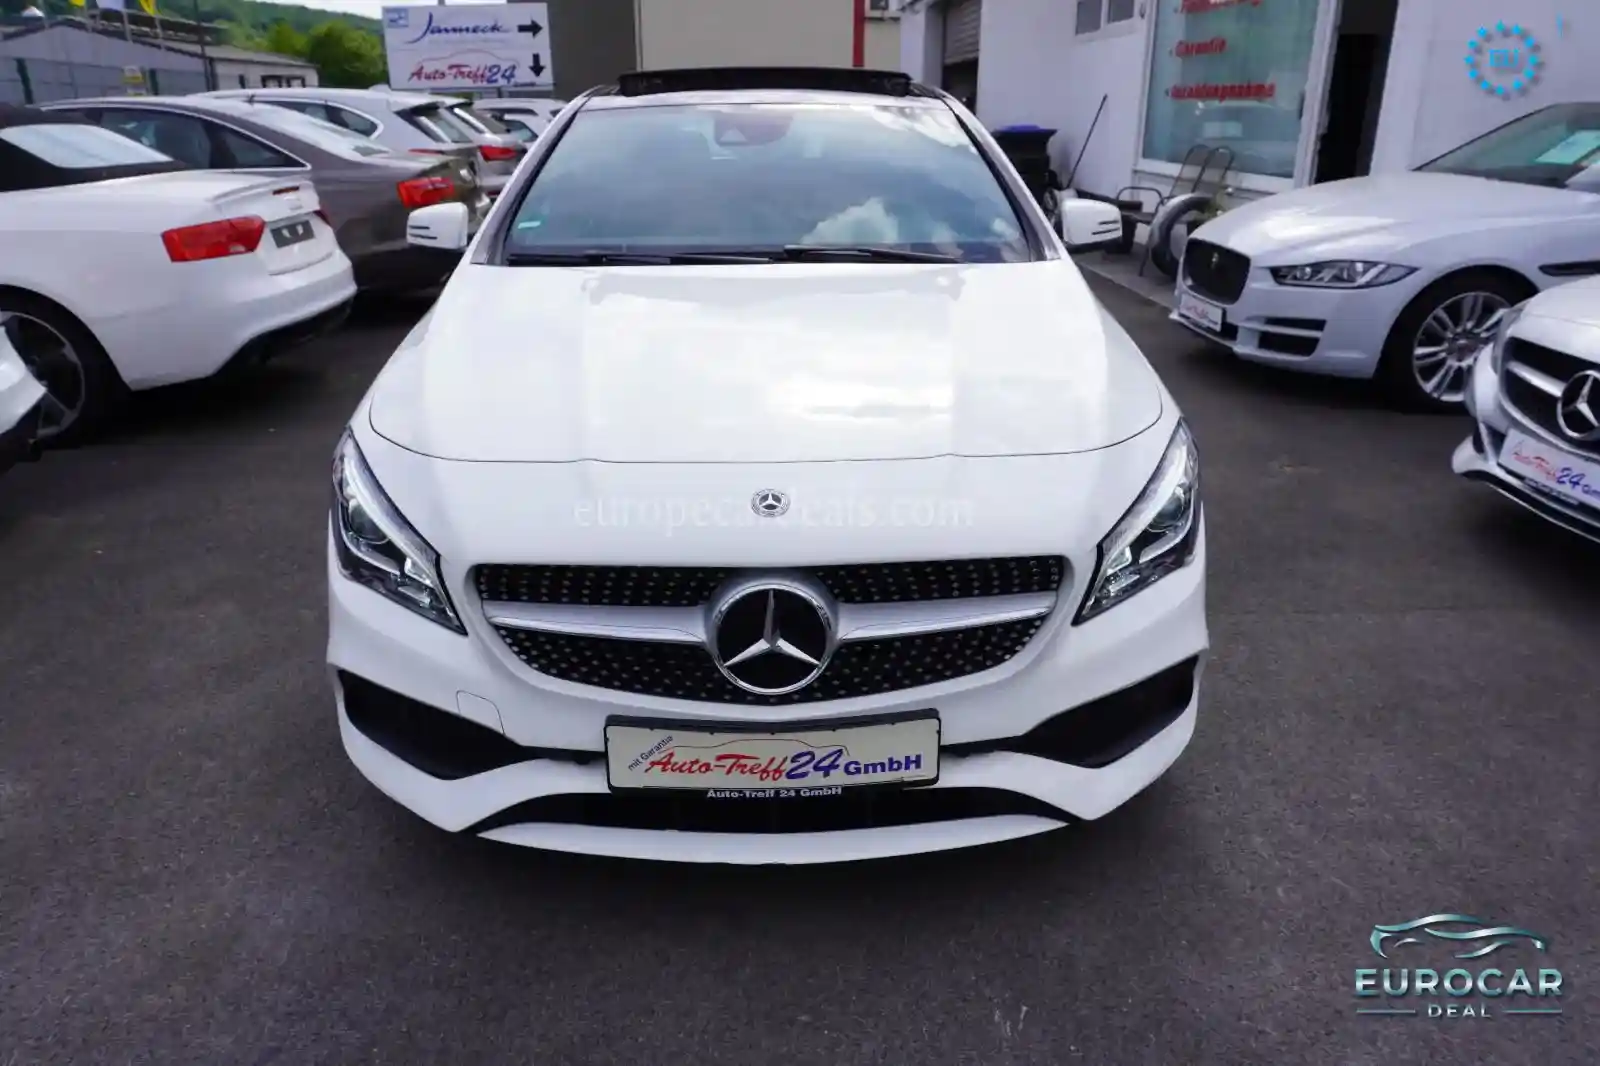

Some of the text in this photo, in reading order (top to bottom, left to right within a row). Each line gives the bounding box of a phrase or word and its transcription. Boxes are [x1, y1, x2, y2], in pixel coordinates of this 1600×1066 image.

[628, 758, 642, 771] mit
[843, 754, 922, 776] GmbH
[706, 785, 843, 799] Auto-Treff 24 GmbH
